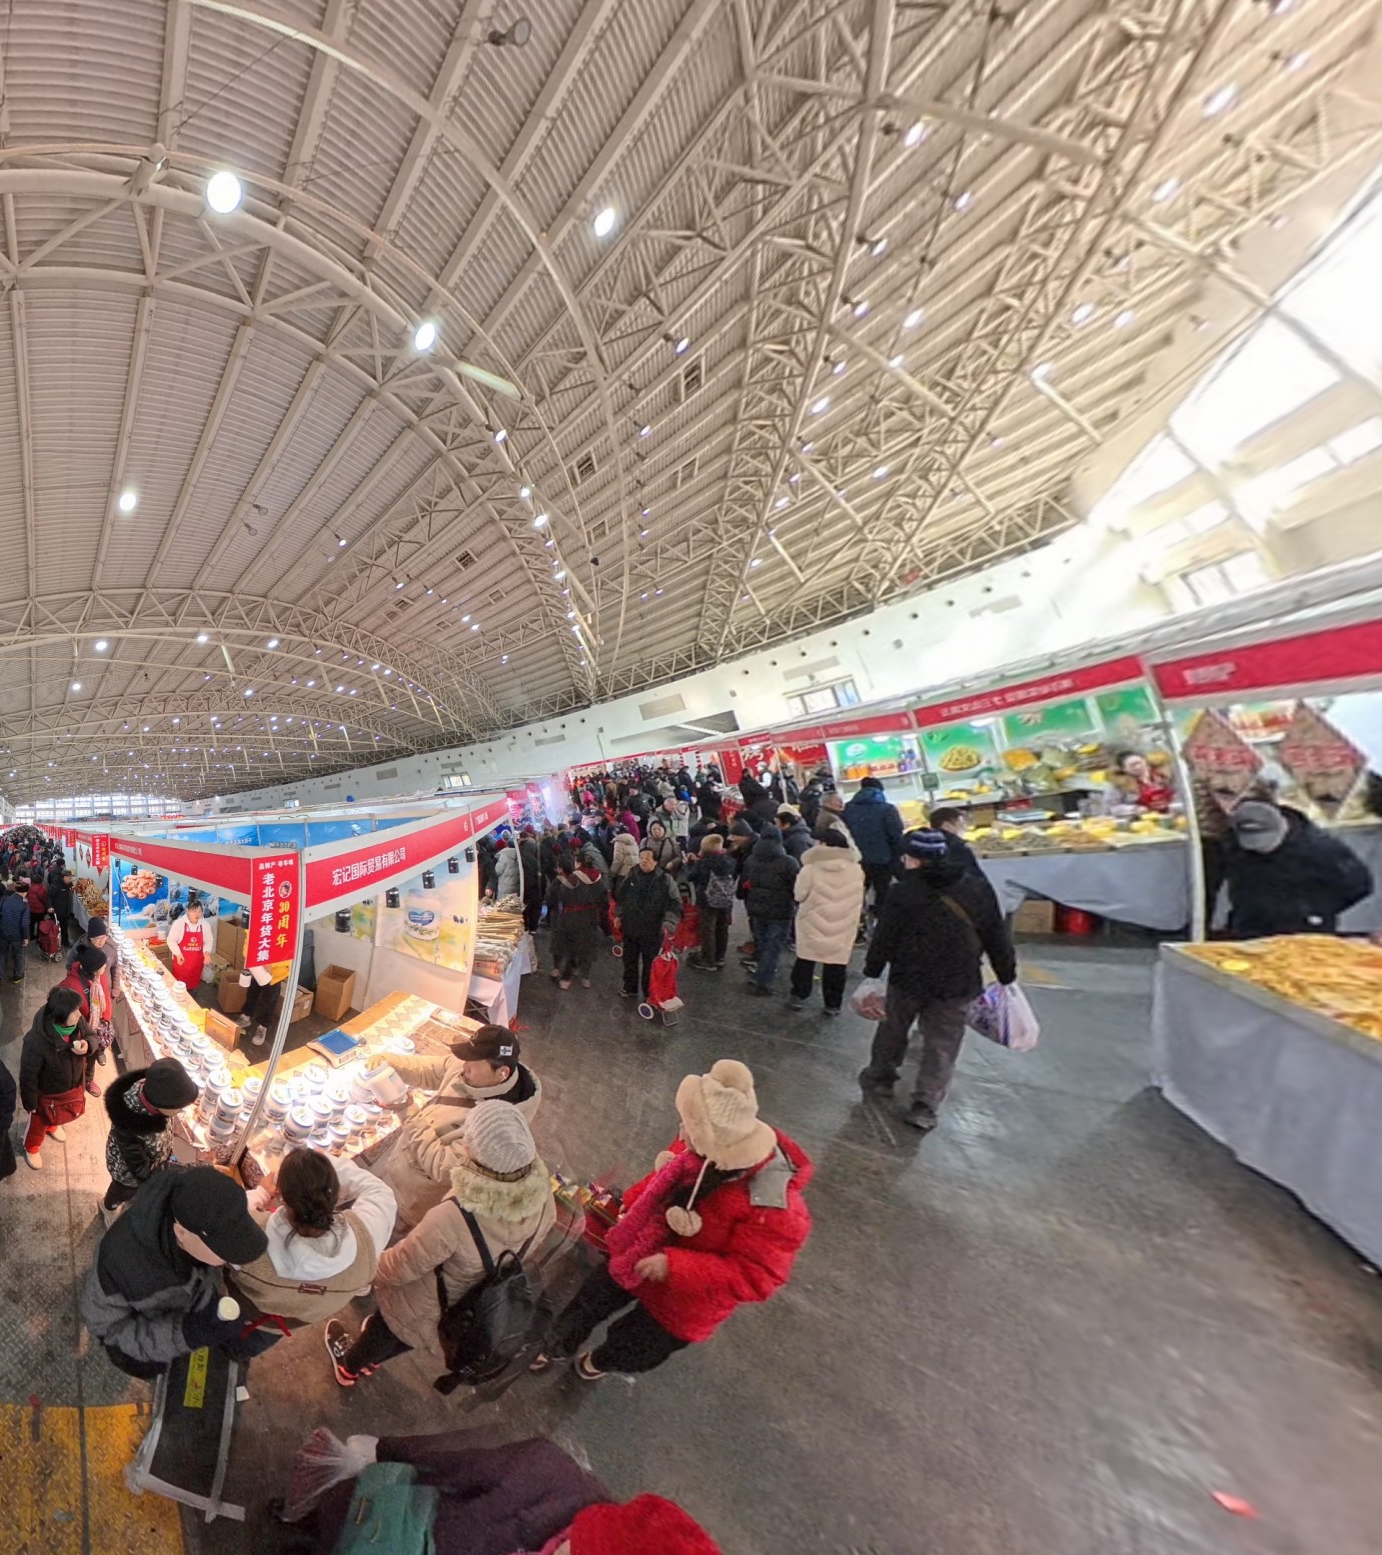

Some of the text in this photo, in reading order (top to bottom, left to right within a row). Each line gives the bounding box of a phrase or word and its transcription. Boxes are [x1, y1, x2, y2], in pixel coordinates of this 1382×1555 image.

[332, 847, 407, 886] 宏记国际贸易有限公司
[256, 872, 276, 962] 老北京年货大集
[275, 900, 291, 948] 30周年
